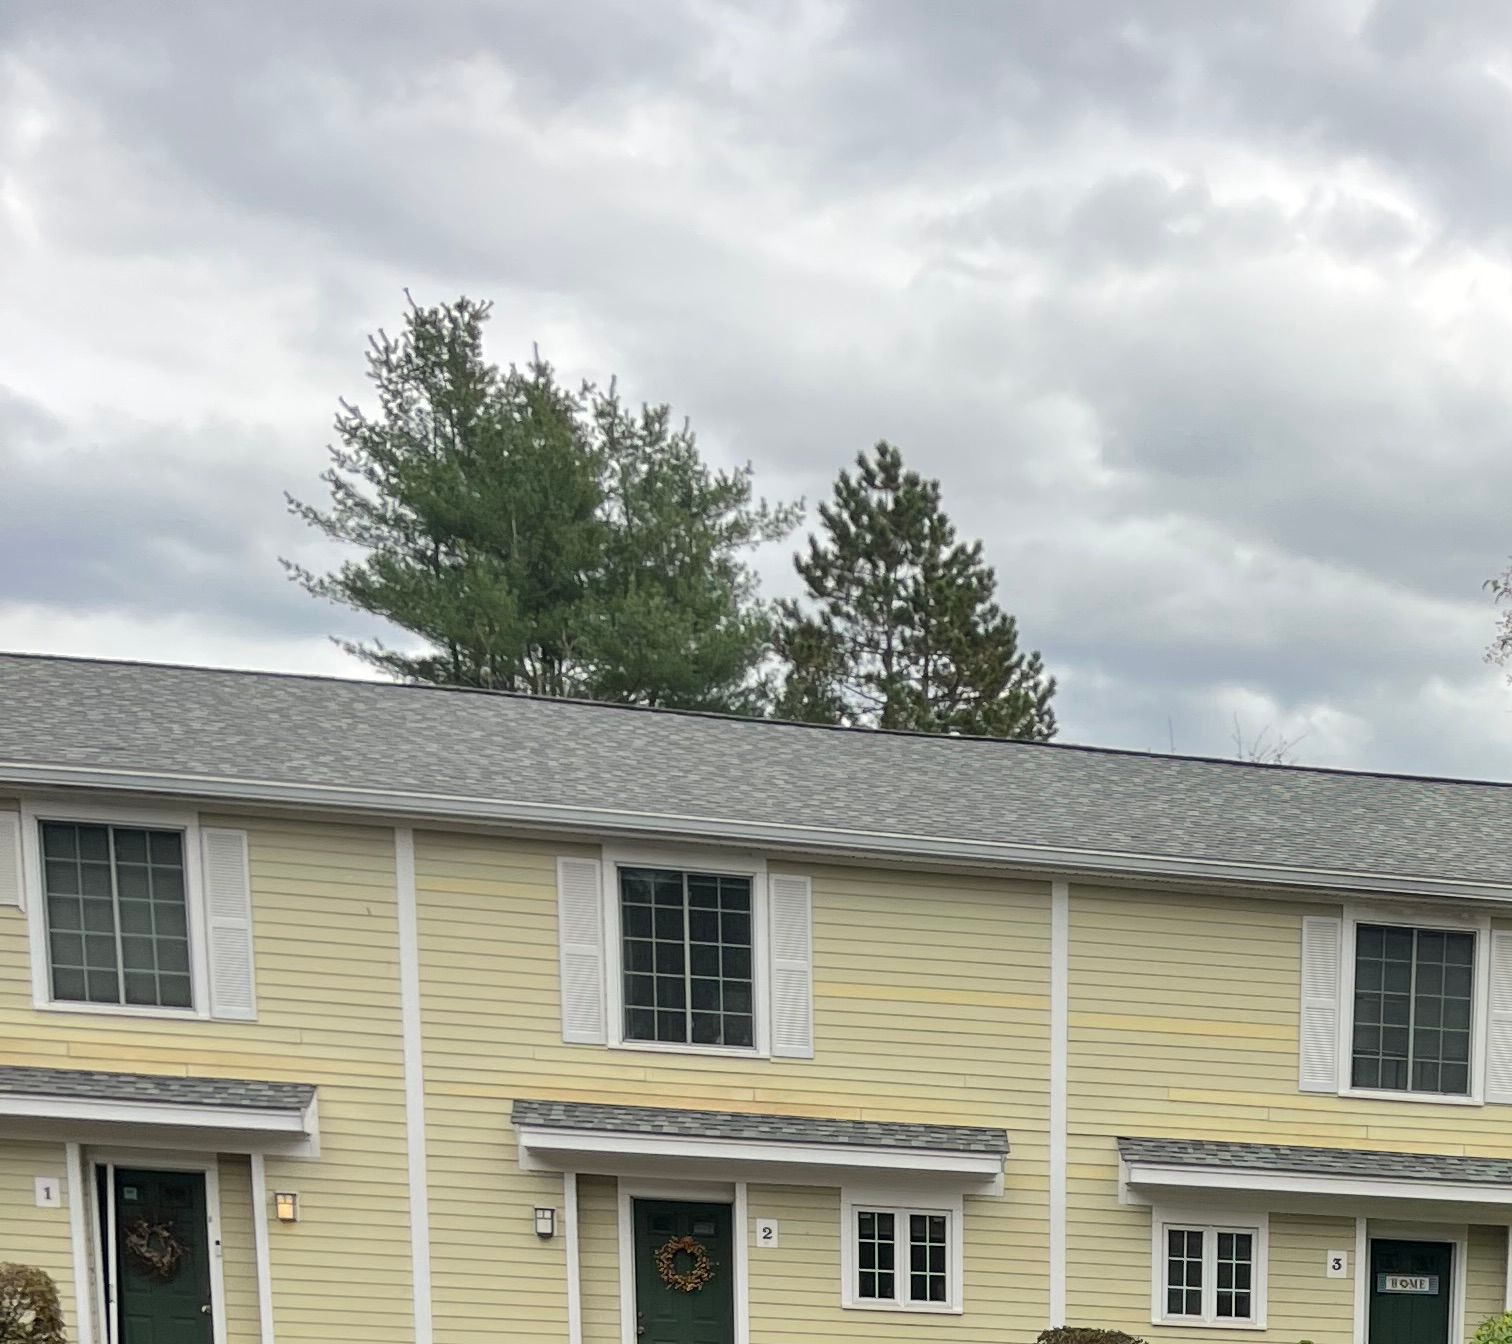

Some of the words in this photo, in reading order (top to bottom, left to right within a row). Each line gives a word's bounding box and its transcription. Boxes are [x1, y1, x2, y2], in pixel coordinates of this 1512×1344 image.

[43, 1186, 52, 1200] 1
[762, 1226, 773, 1240] 2
[1332, 1258, 1343, 1271] 3
